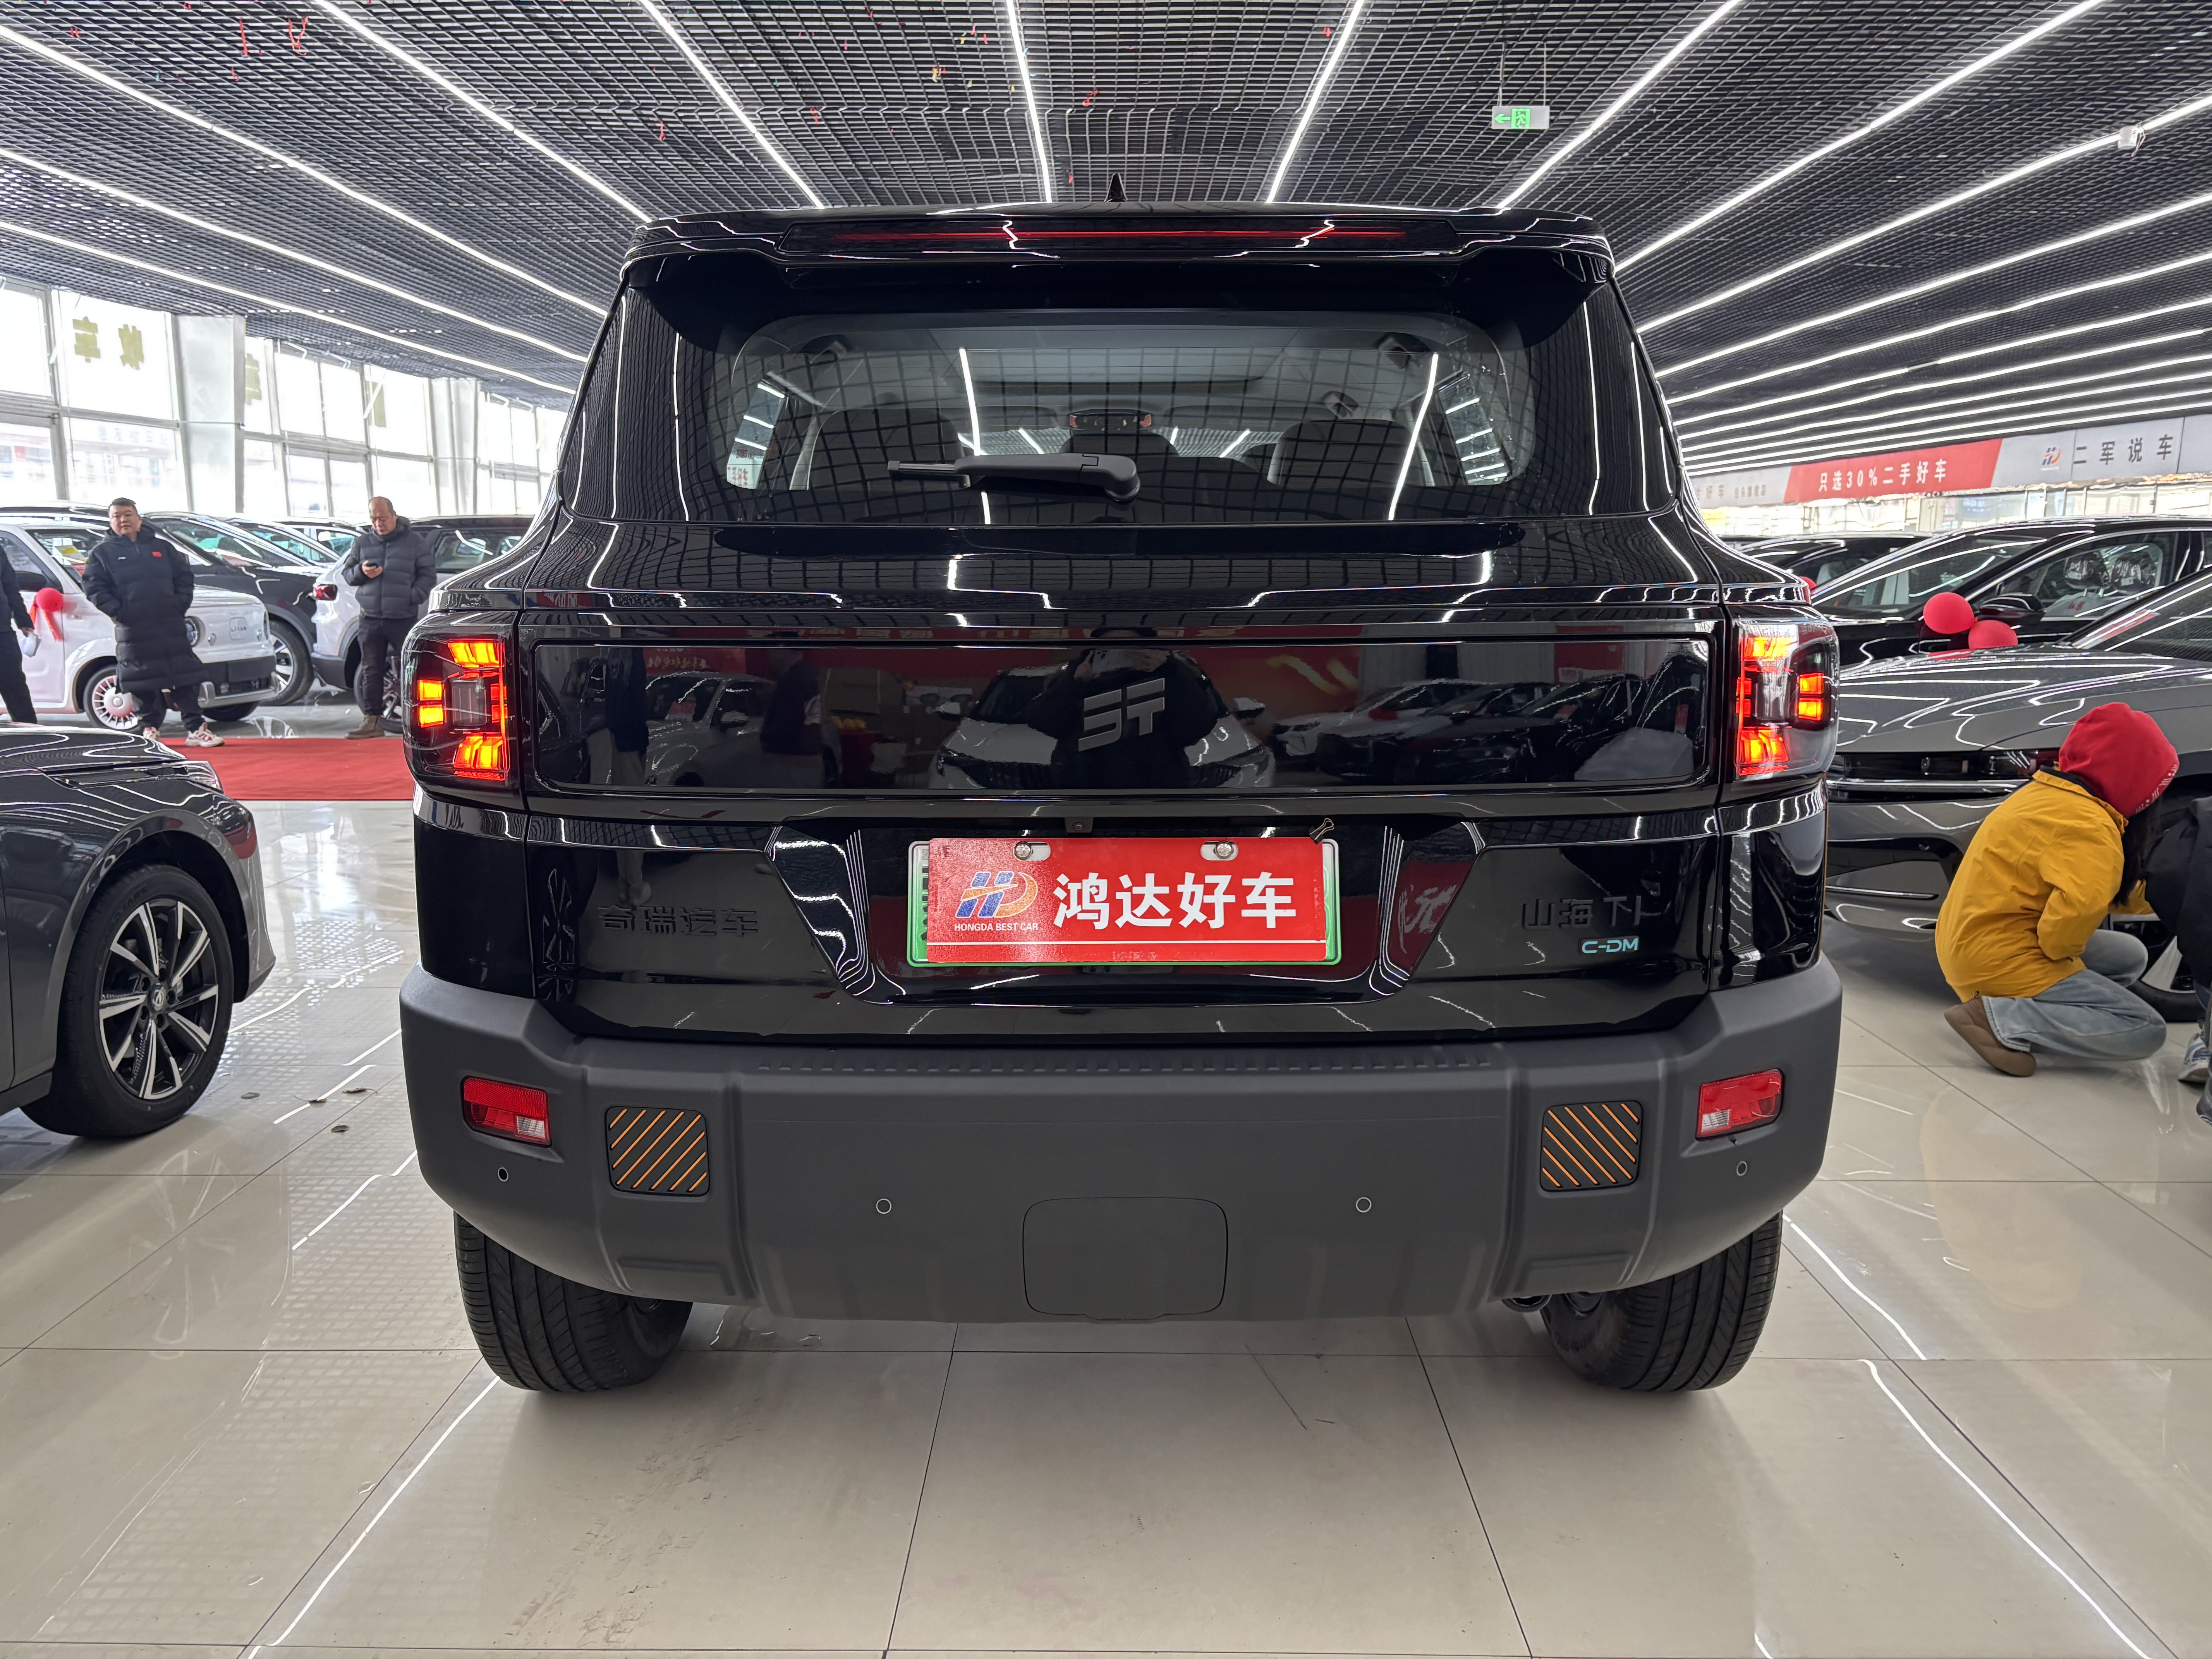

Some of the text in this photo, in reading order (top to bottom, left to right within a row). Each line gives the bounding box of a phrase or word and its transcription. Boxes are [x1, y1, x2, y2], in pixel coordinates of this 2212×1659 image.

[2073, 434, 2173, 465] 二军说车
[1053, 871, 1297, 930] 鸿达好车
[598, 904, 759, 937] 奇瑞汽车
[954, 922, 1039, 931] HONGDA BEST CAR
[1582, 938, 1638, 954] C-DM
